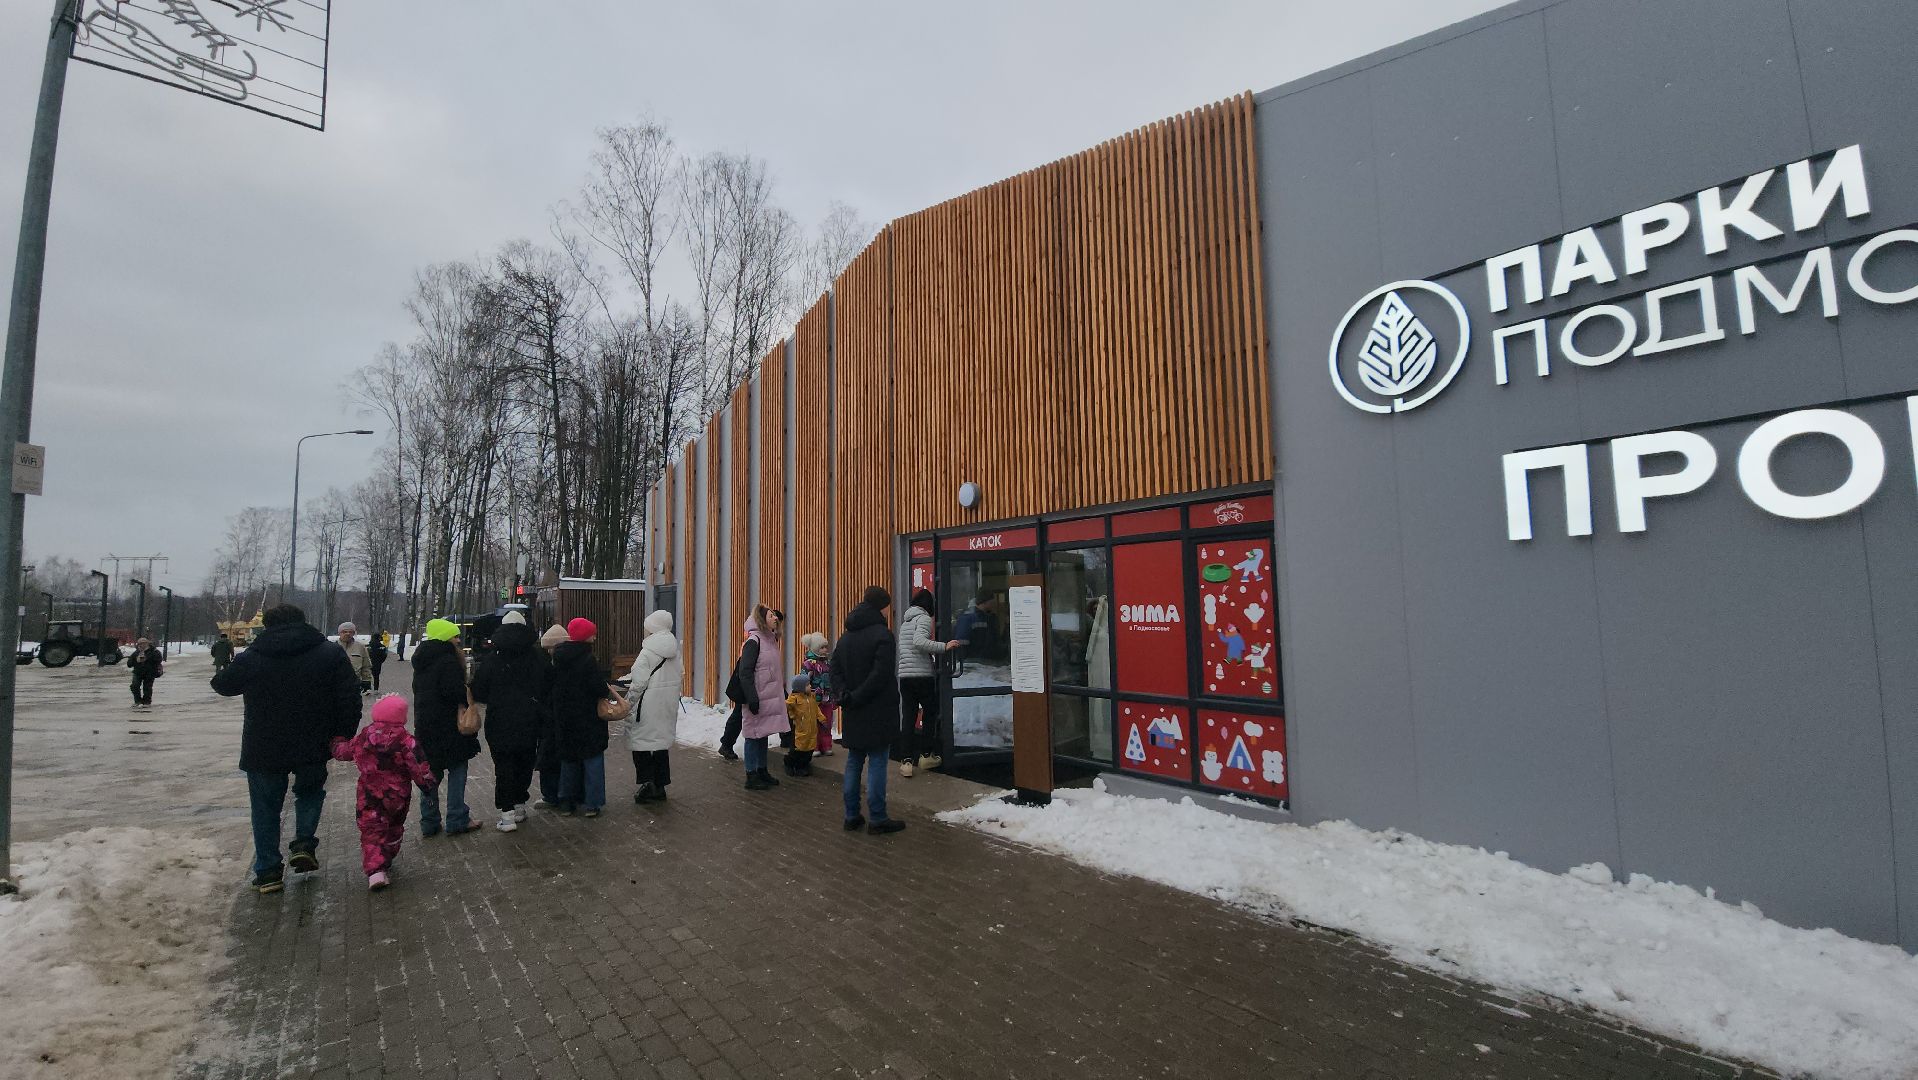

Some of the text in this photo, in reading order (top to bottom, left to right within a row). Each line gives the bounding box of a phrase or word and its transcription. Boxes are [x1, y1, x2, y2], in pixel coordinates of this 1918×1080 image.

[1486, 144, 1871, 313] ПАРКИ
[1493, 229, 1918, 385] ПОДМО
[1503, 396, 1918, 541] ПРО
[969, 535, 1002, 550] КАТОК
[1120, 604, 1180, 623] ЗИМА
